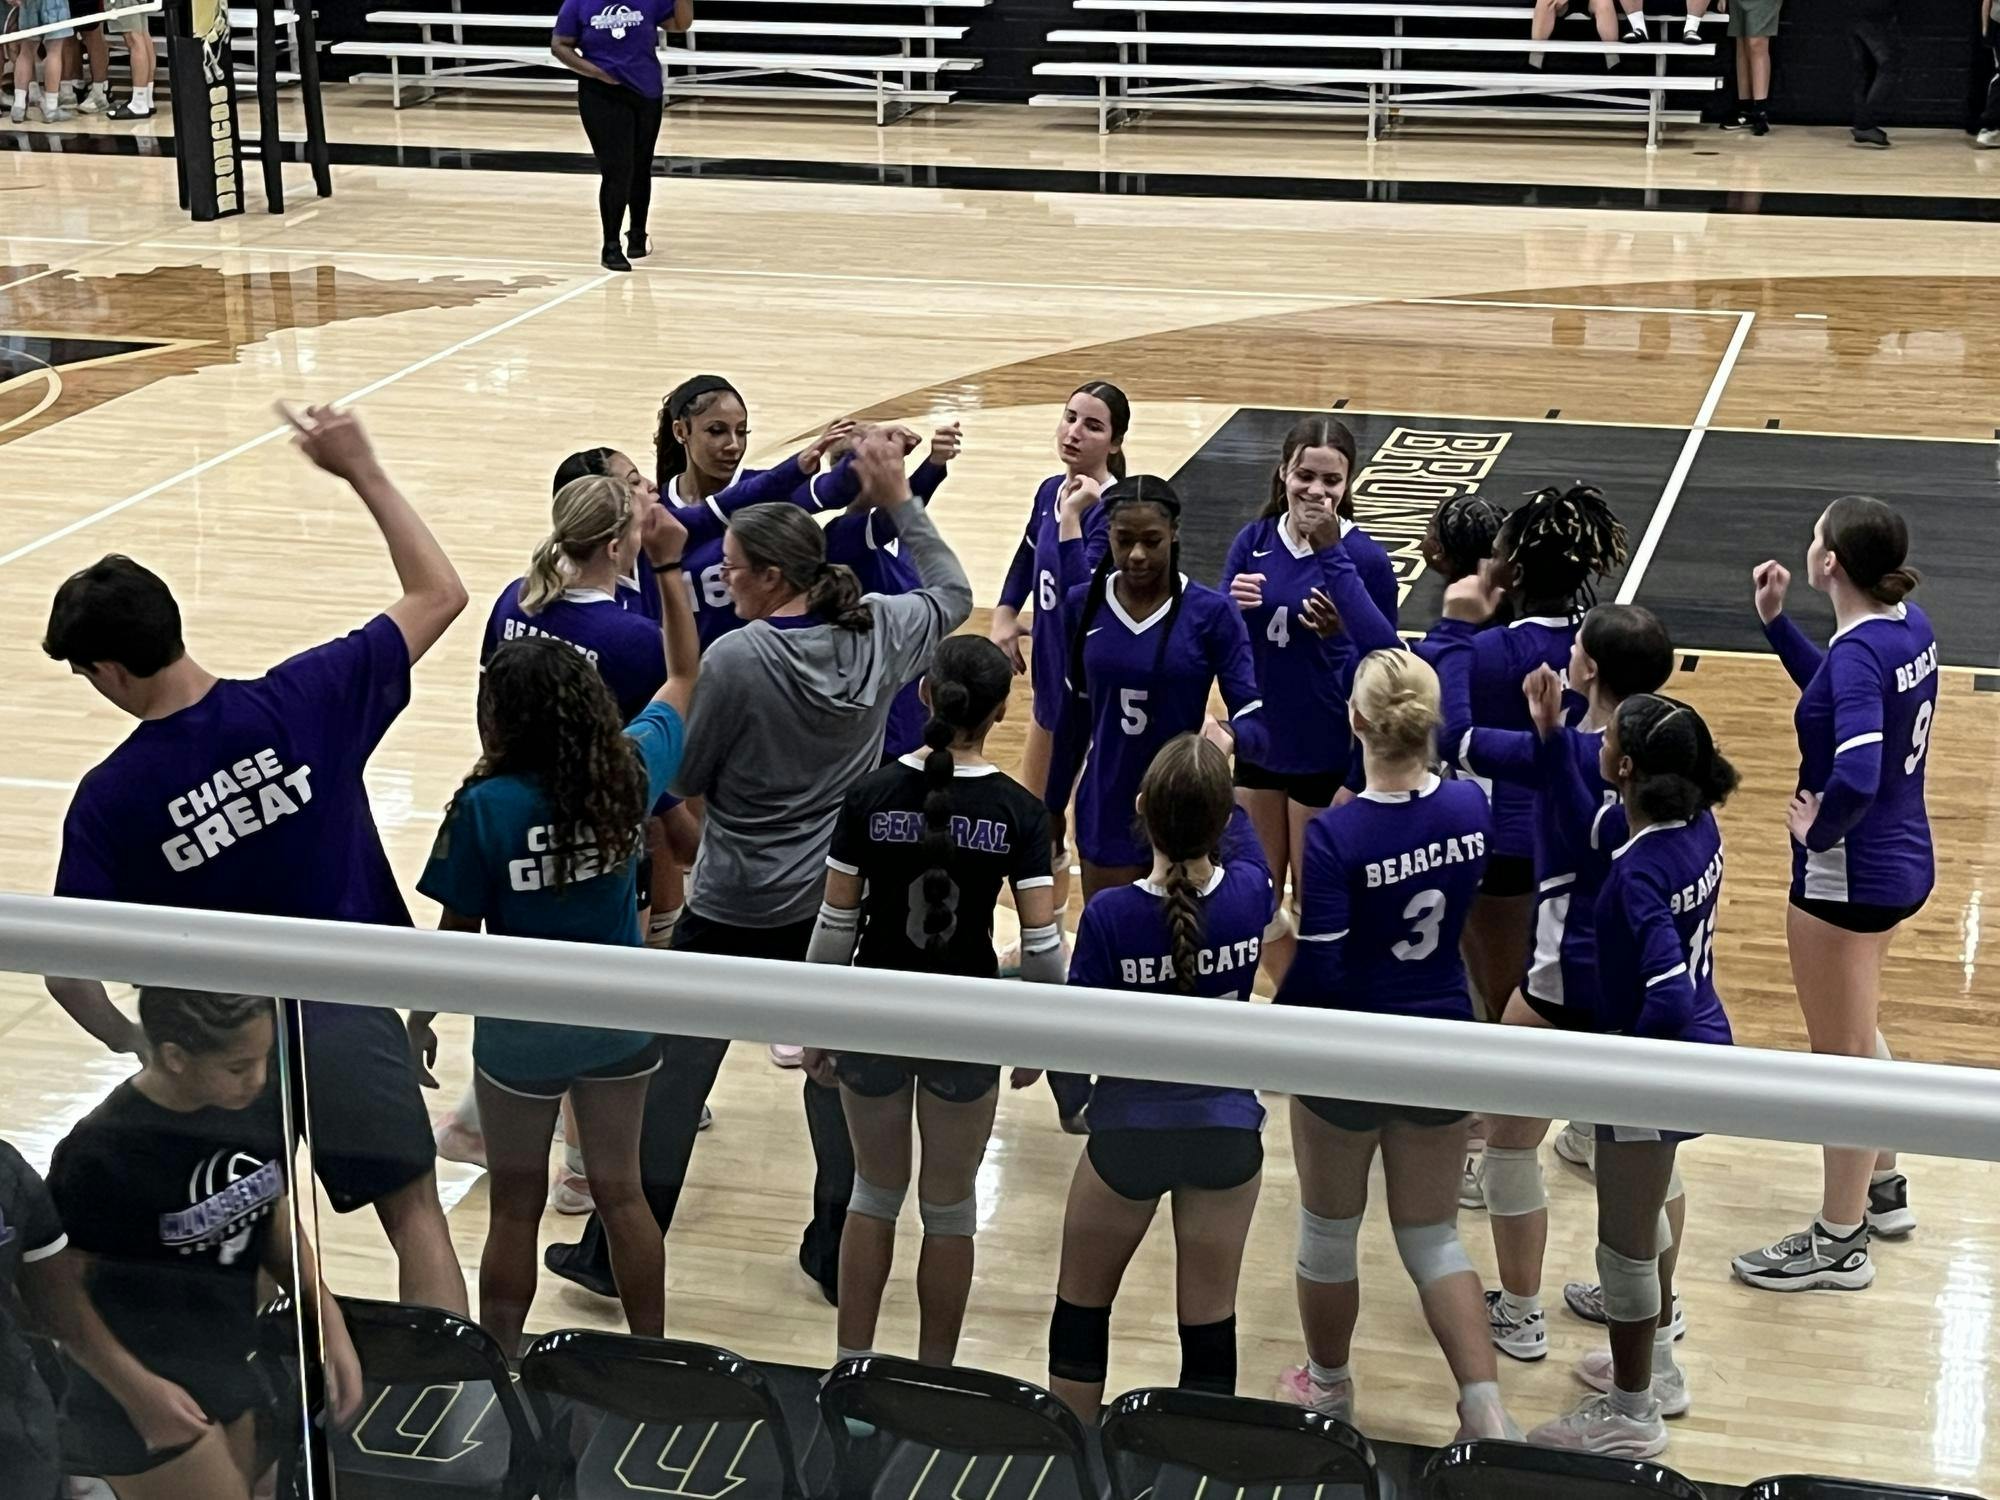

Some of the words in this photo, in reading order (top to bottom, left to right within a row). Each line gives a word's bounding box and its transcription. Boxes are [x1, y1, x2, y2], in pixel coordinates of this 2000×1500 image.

[209, 85, 238, 213] BRONCOS
[1351, 426, 1513, 608] BRON
[1039, 569, 1057, 611] 6
[1266, 605, 1290, 648] 4
[1120, 688, 1149, 735] 5
[1904, 700, 1933, 776] 9
[161, 764, 312, 872] GREAT
[168, 748, 283, 828] CHASE
[869, 811, 1011, 854] CENRAL
[1365, 831, 1485, 888] BEARCATS
[1390, 889, 1447, 962] 3
[1120, 936, 1260, 984] BEACATS
